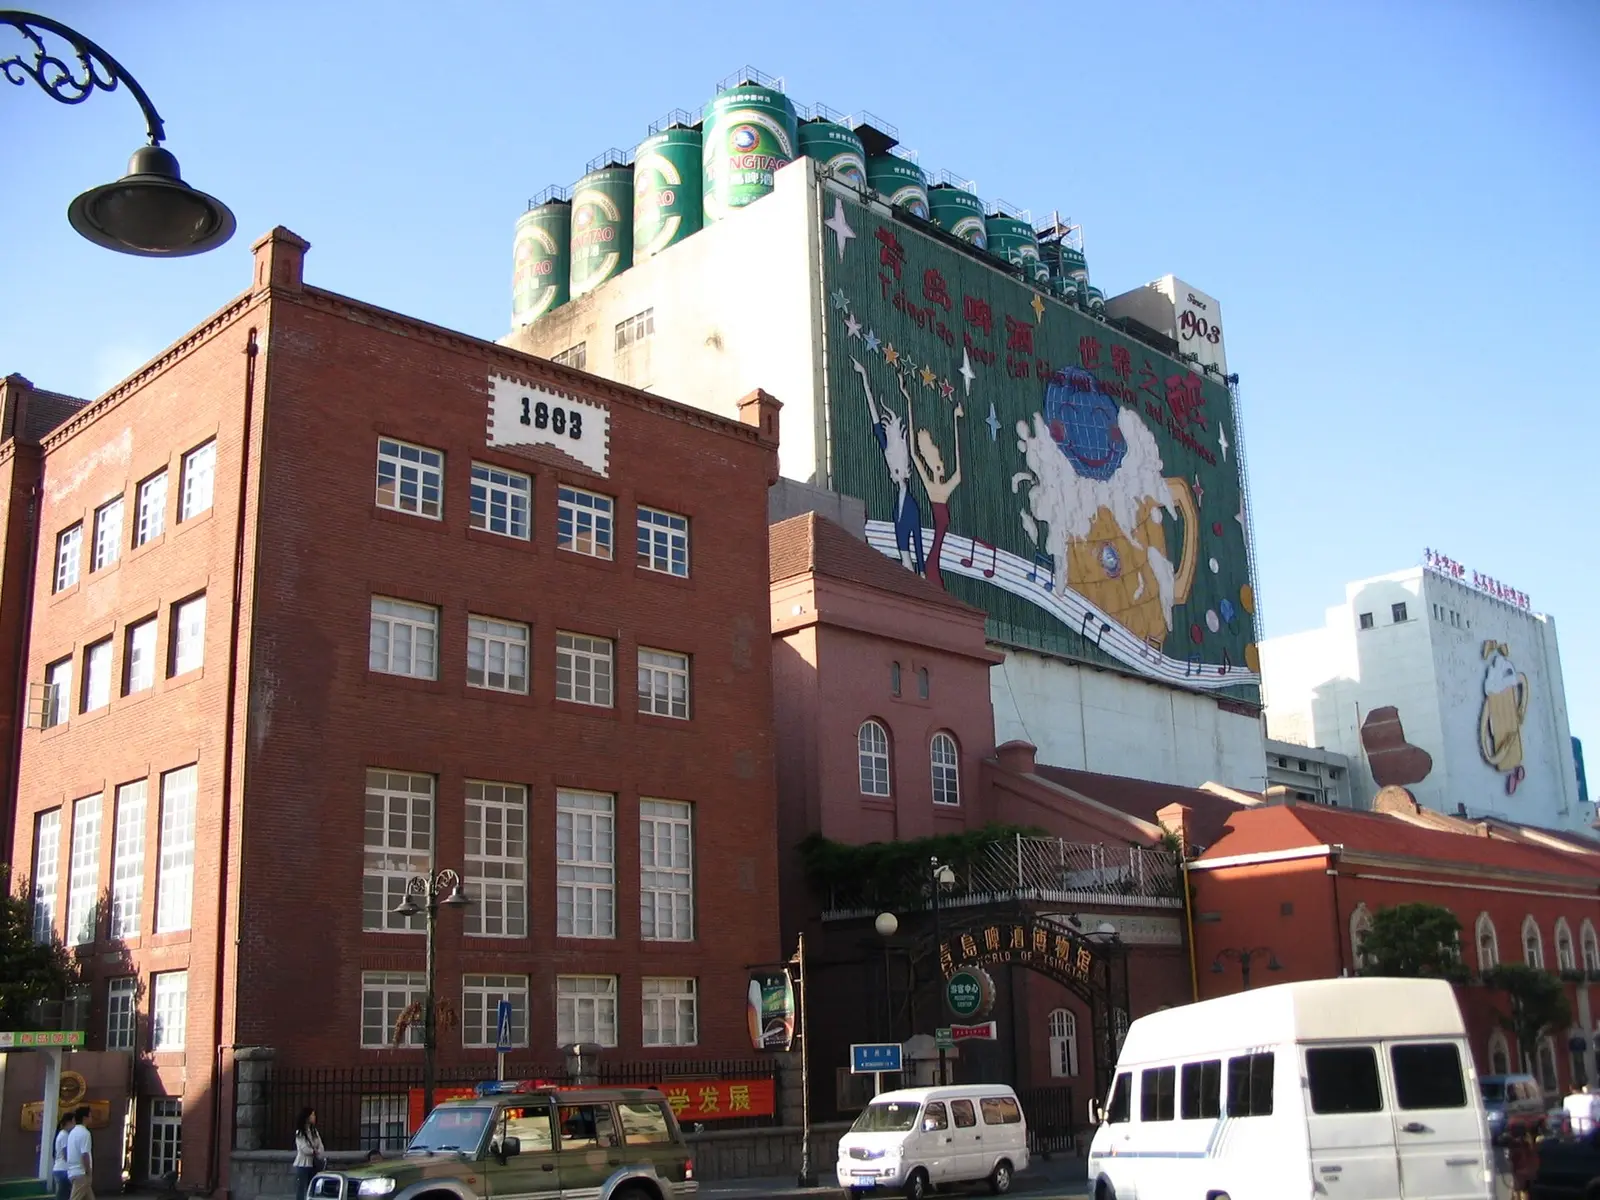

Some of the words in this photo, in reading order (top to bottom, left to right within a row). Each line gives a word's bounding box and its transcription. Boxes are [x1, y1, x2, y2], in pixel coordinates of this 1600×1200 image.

[1187, 293, 1207, 311] Since
[1177, 310, 1220, 344] 1903
[520, 397, 582, 440] 1903
[1020, 950, 1033, 961] OF
